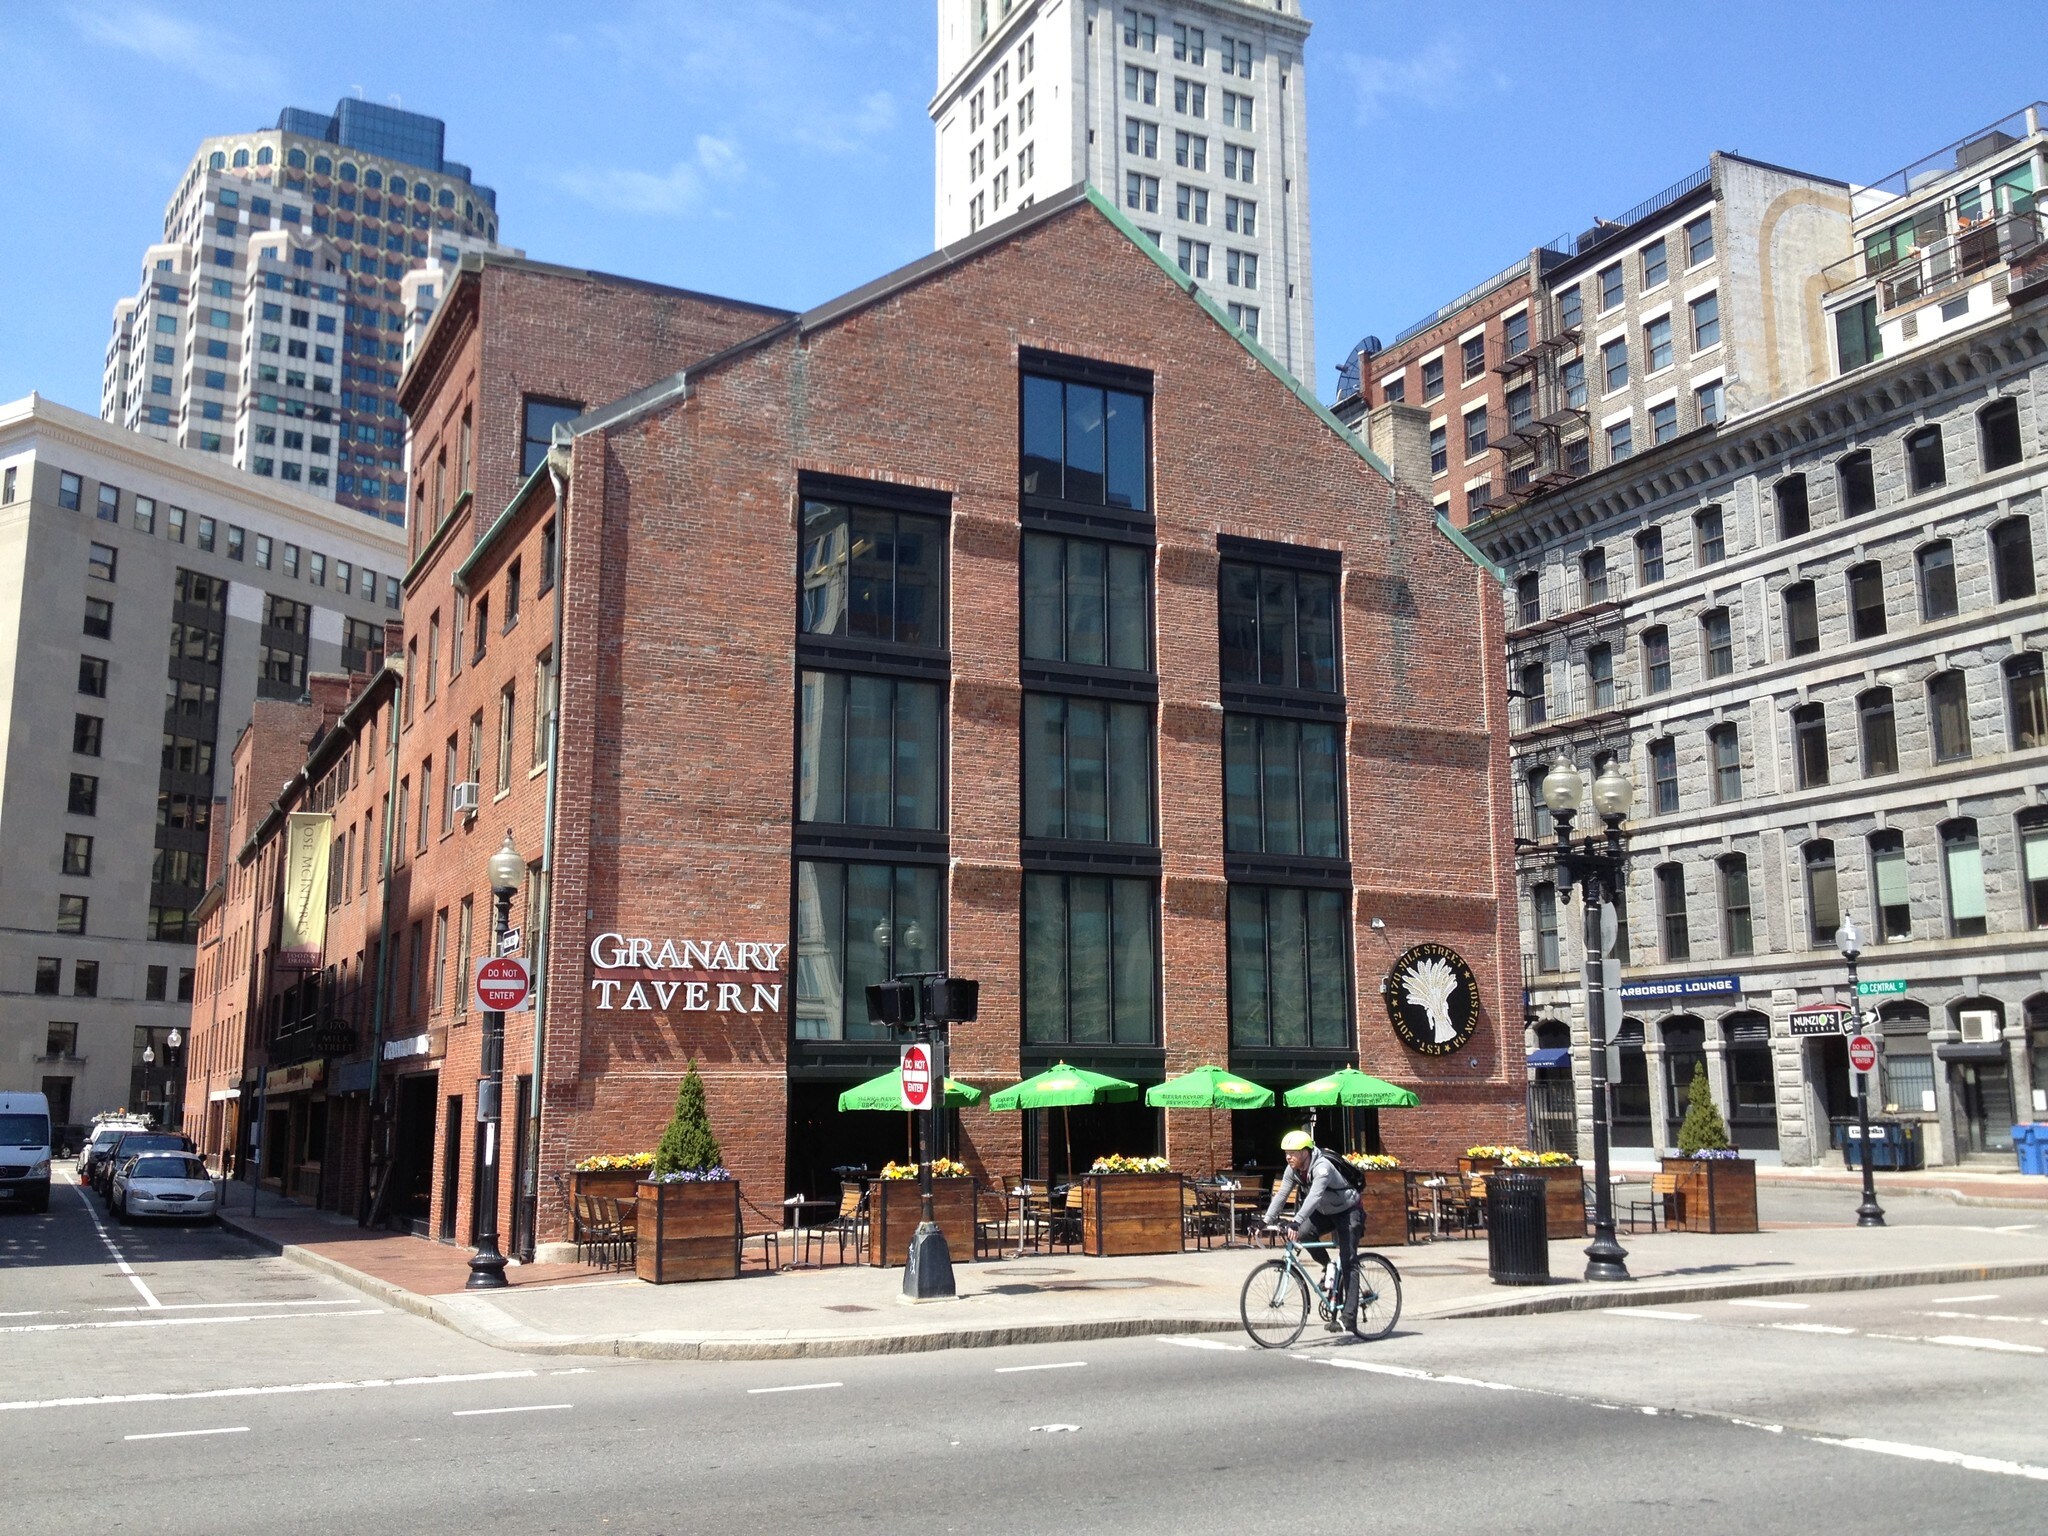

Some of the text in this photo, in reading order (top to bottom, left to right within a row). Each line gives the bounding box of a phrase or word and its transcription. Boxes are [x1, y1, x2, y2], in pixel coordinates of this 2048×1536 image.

[303, 823, 316, 850] JOSE
[590, 933, 787, 971] GRANARY
[488, 969, 517, 977] DO NOT
[1391, 945, 1465, 995] 170 MILK STREET
[1685, 980, 1733, 992] LOUNGE
[1869, 982, 1897, 993] CENTRAL
[489, 991, 514, 999] ENTER
[591, 980, 782, 1014] TAVERN
[1453, 982, 1479, 1048] BOSTON MA
[1793, 1013, 1835, 1026] NUNZIO'S
[329, 1021, 346, 1030] 170
[1393, 1011, 1413, 1041] 2012
[904, 1060, 925, 1069] DO NOT
[907, 1083, 924, 1093] ENTER
